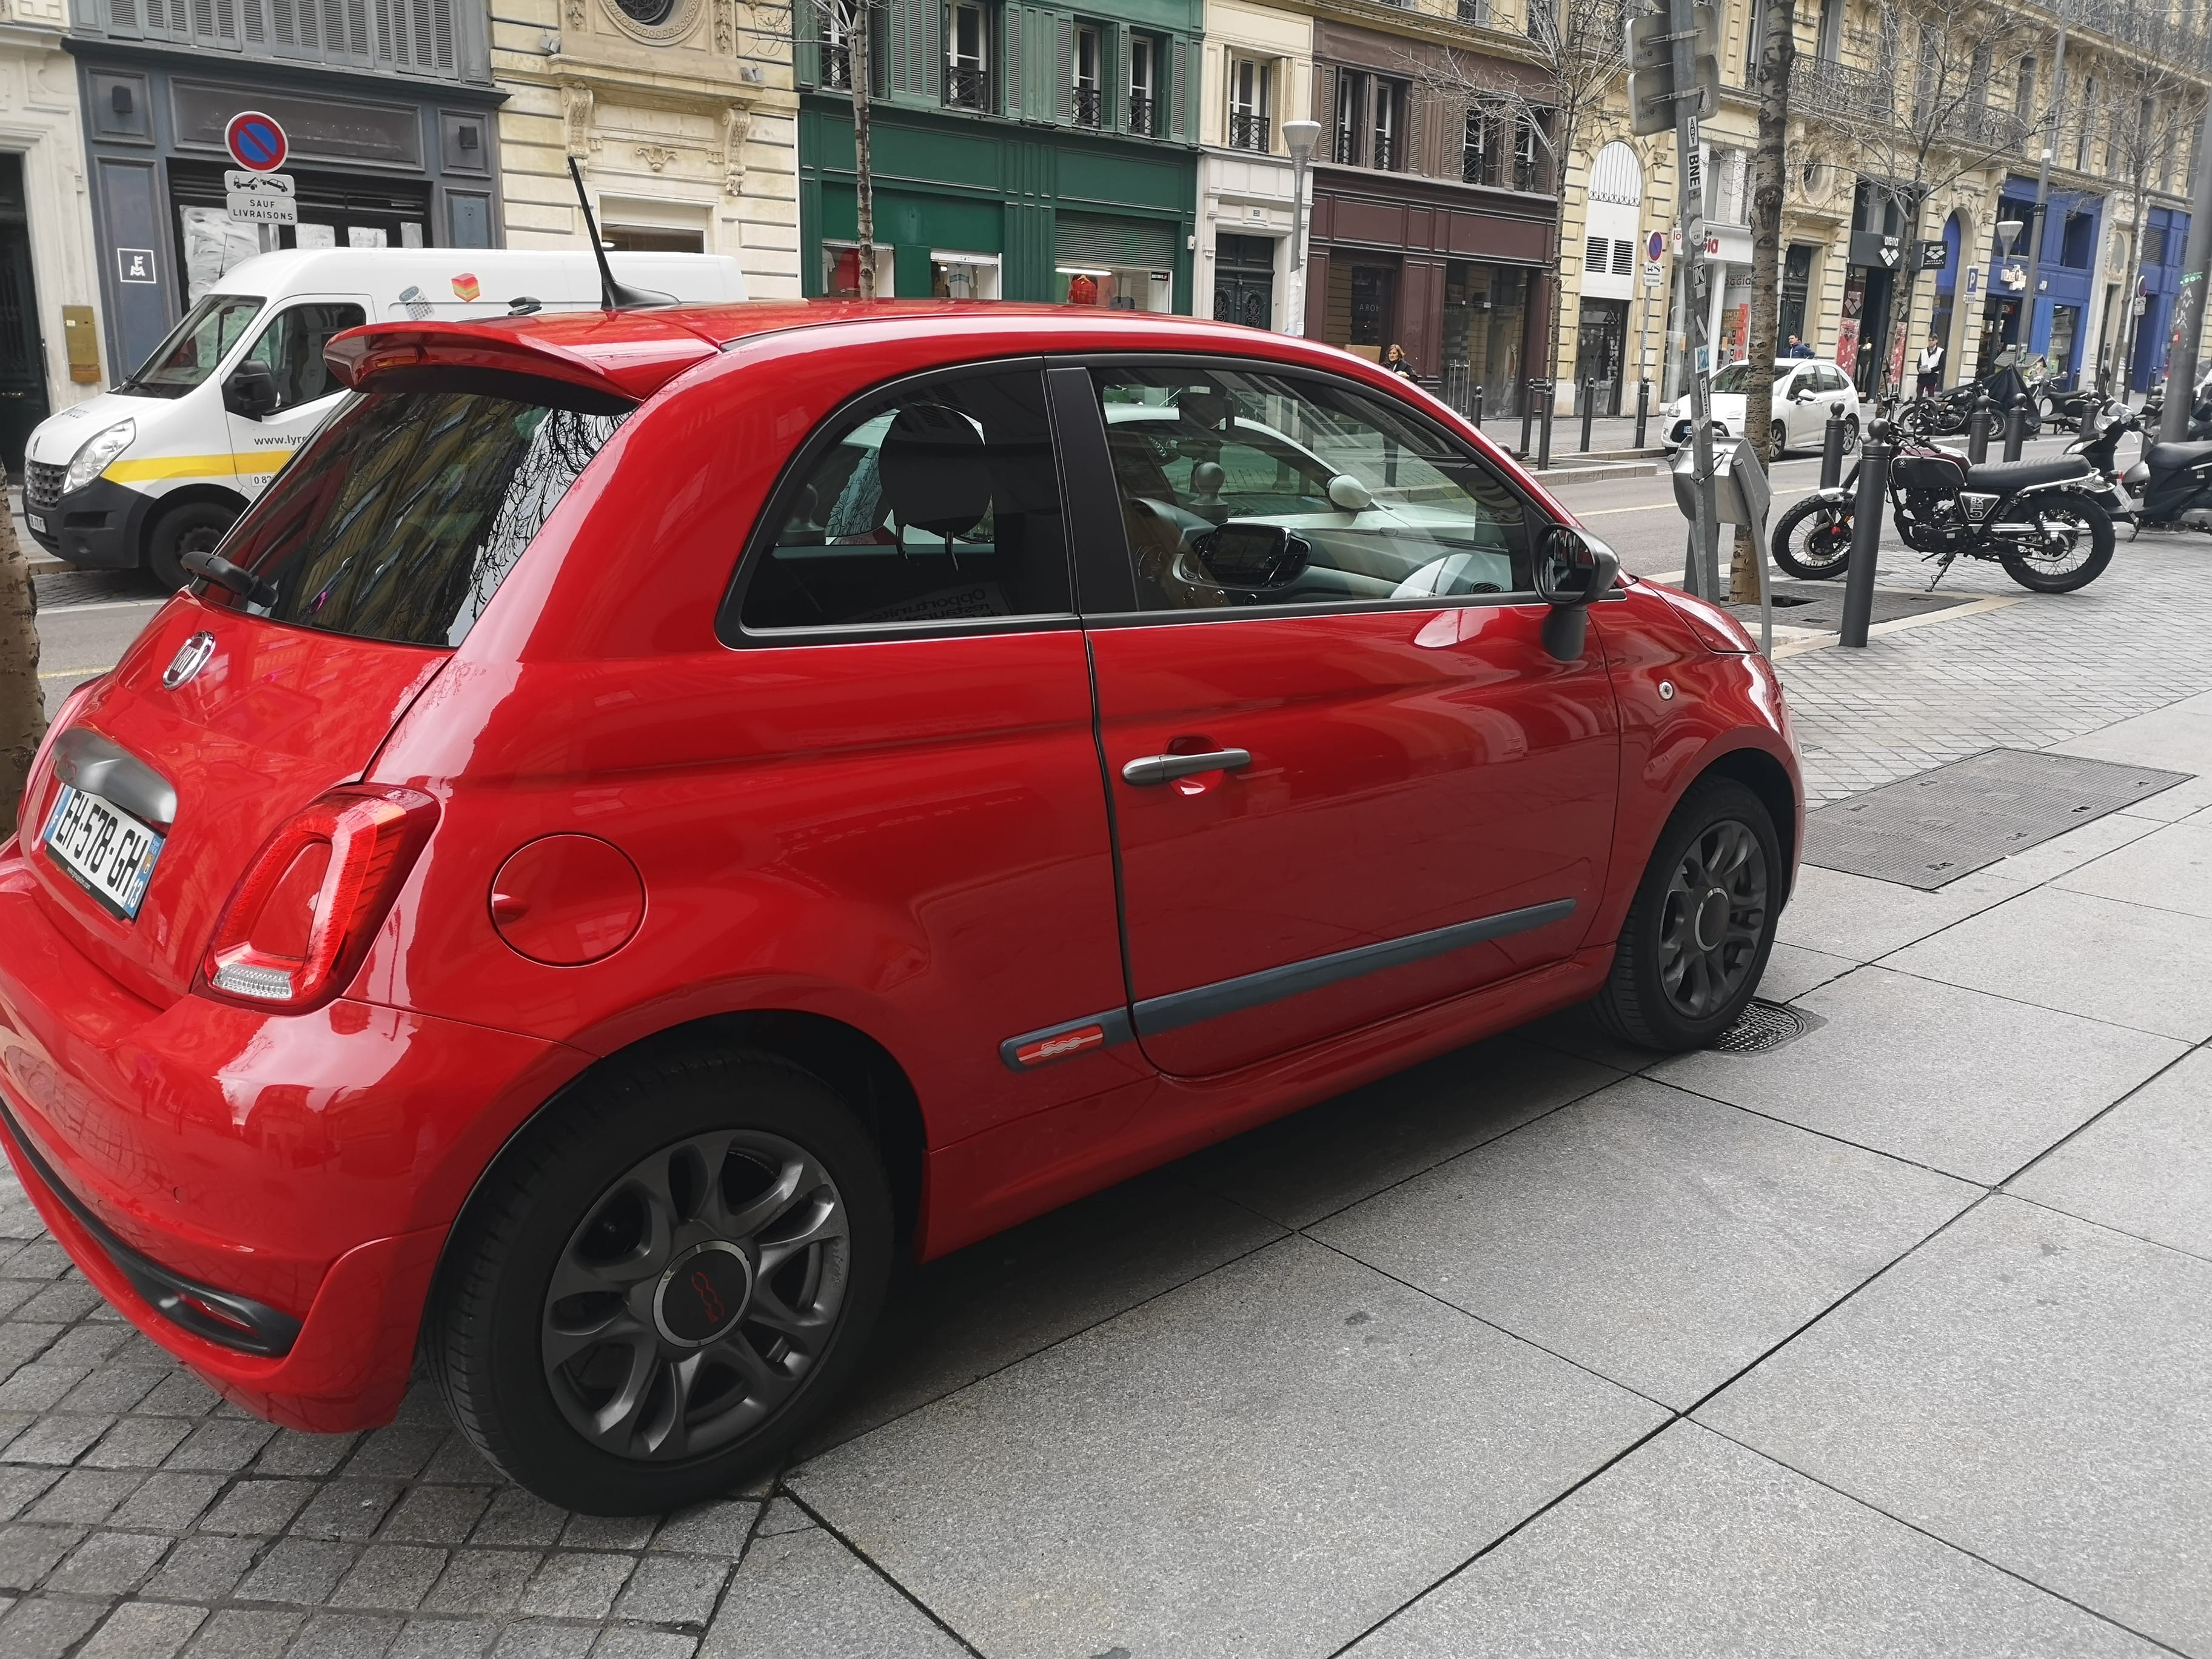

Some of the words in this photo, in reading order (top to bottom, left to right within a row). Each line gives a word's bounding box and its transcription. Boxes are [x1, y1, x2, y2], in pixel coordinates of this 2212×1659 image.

[1689, 155, 1700, 187] BNE
[250, 199, 275, 208] SAUF
[233, 209, 293, 220] LIVRAISONS
[1969, 272, 1975, 289] P
[55, 789, 149, 897] EH-578-GH
[127, 878, 144, 908] 13
[1041, 1037, 1081, 1057] 500
